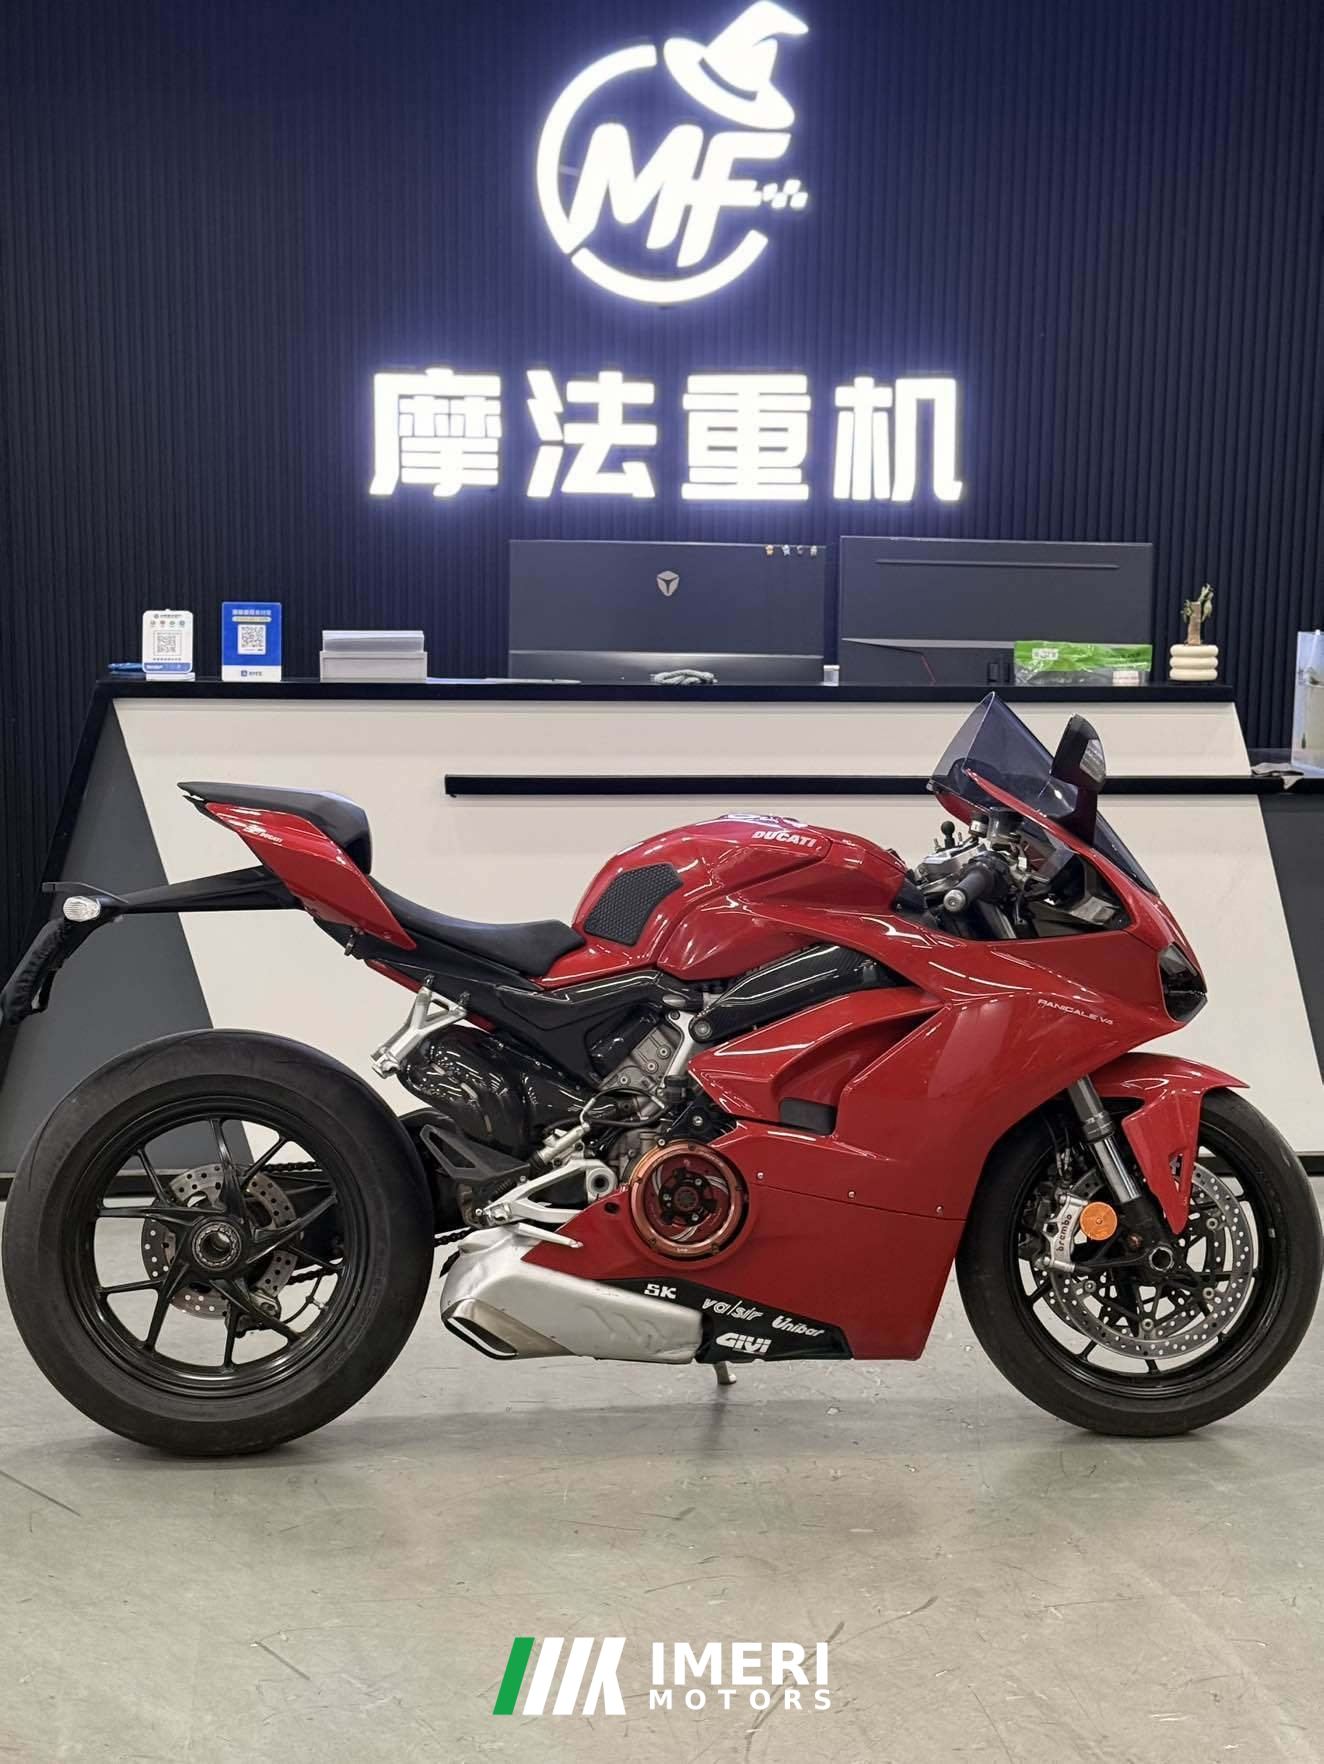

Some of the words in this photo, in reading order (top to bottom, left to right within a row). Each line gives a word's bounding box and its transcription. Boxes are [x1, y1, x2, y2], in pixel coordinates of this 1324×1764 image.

[566, 123, 793, 268] MF
[369, 367, 964, 502] 摩法重机
[752, 831, 817, 848] DUCATI
[1055, 1213, 1073, 1252] brembo
[644, 1283, 677, 1299] SK
[771, 1315, 825, 1337] Unibar
[715, 1332, 772, 1354] GIVI
